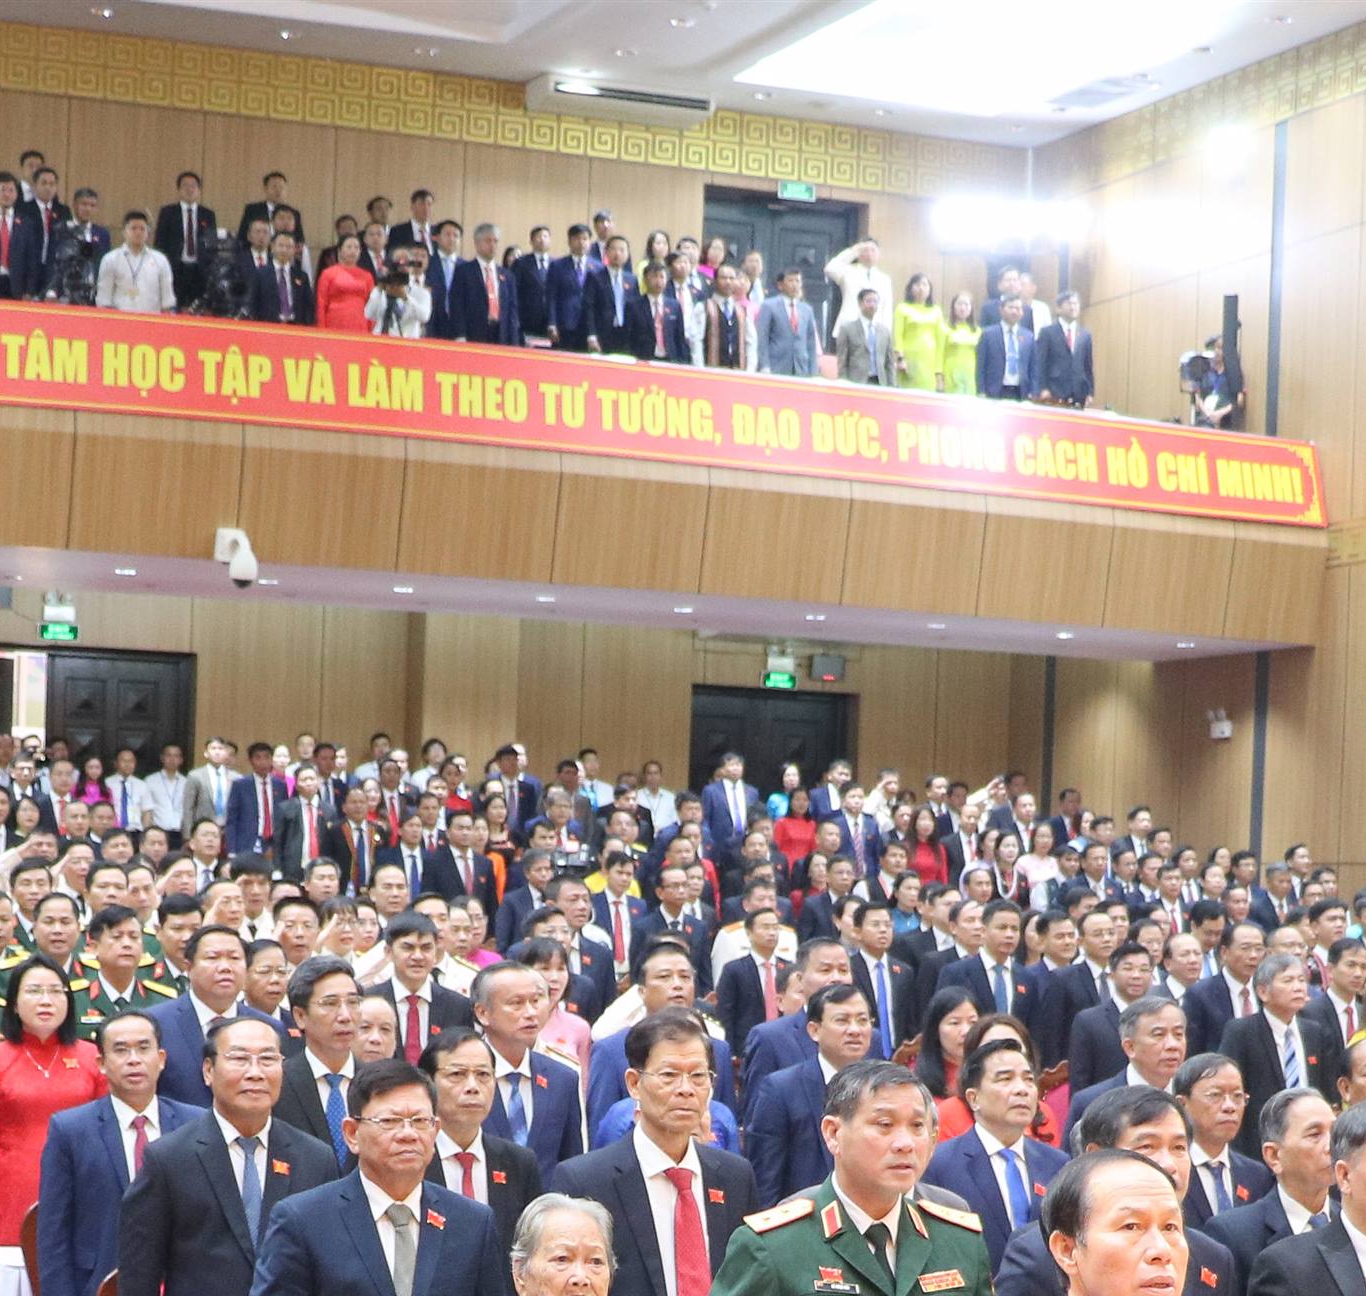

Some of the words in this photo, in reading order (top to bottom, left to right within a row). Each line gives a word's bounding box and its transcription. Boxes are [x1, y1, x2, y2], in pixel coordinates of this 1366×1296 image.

[1, 329, 88, 384] TÂM
[102, 345, 186, 398] HỌC
[198, 345, 272, 405] TẬP
[284, 353, 336, 404] VÀ
[348, 358, 424, 413] LÀM
[436, 371, 529, 424] THEO
[539, 380, 590, 429] TƯ
[596, 383, 723, 447] TƯỞNG,
[732, 404, 800, 456] ĐẠO
[811, 407, 889, 464] ĐỨC,
[898, 421, 1007, 473] PHONG
[1014, 432, 1098, 484] CÁCH
[1107, 435, 1149, 489] HỒ
[1156, 450, 1211, 496] CHÍ
[1216, 459, 1304, 505] MINH!
